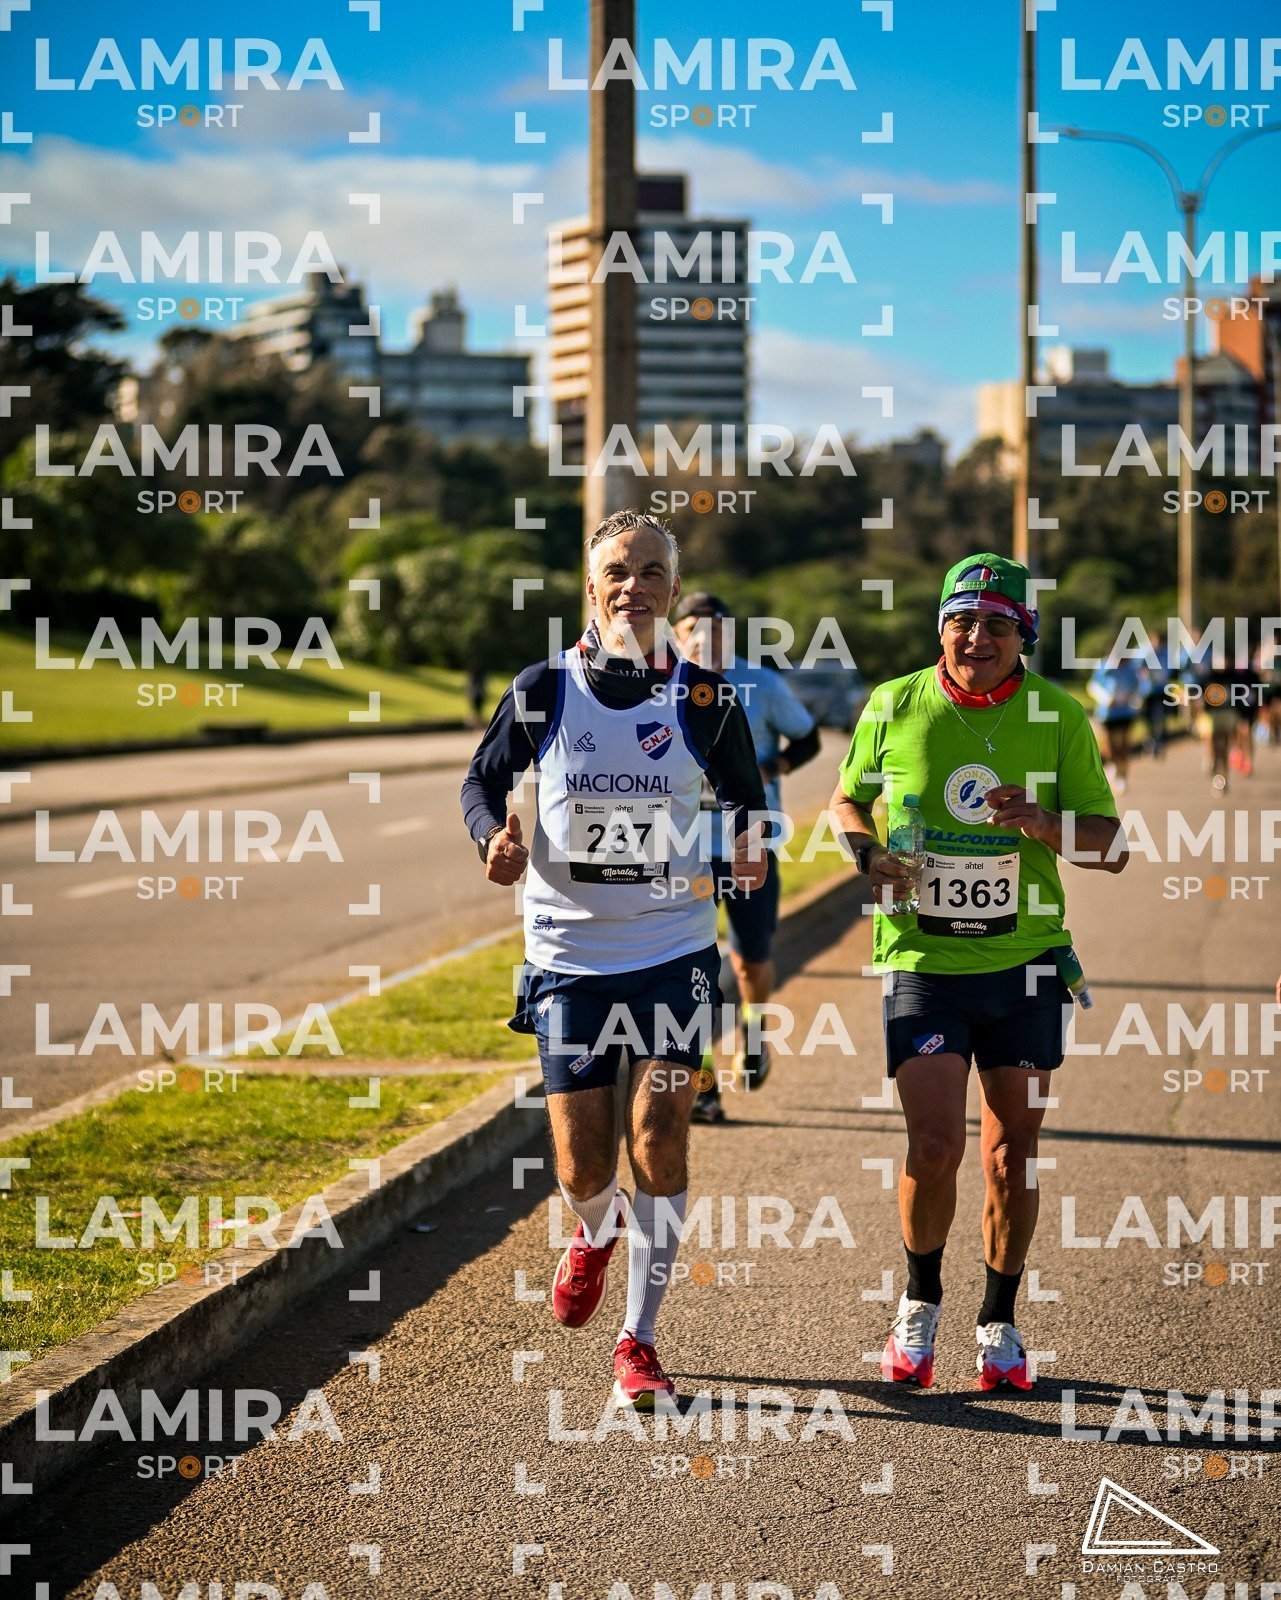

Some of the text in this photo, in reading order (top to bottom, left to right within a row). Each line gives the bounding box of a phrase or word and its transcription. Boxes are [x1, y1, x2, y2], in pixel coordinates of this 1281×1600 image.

[565, 773, 672, 793] NACIONAL
[587, 823, 652, 854] 237
[602, 867, 639, 877] Maratón
[928, 877, 1011, 908] 1363
[951, 921, 988, 931] Maratón
[662, 1039, 691, 1053] PACK
